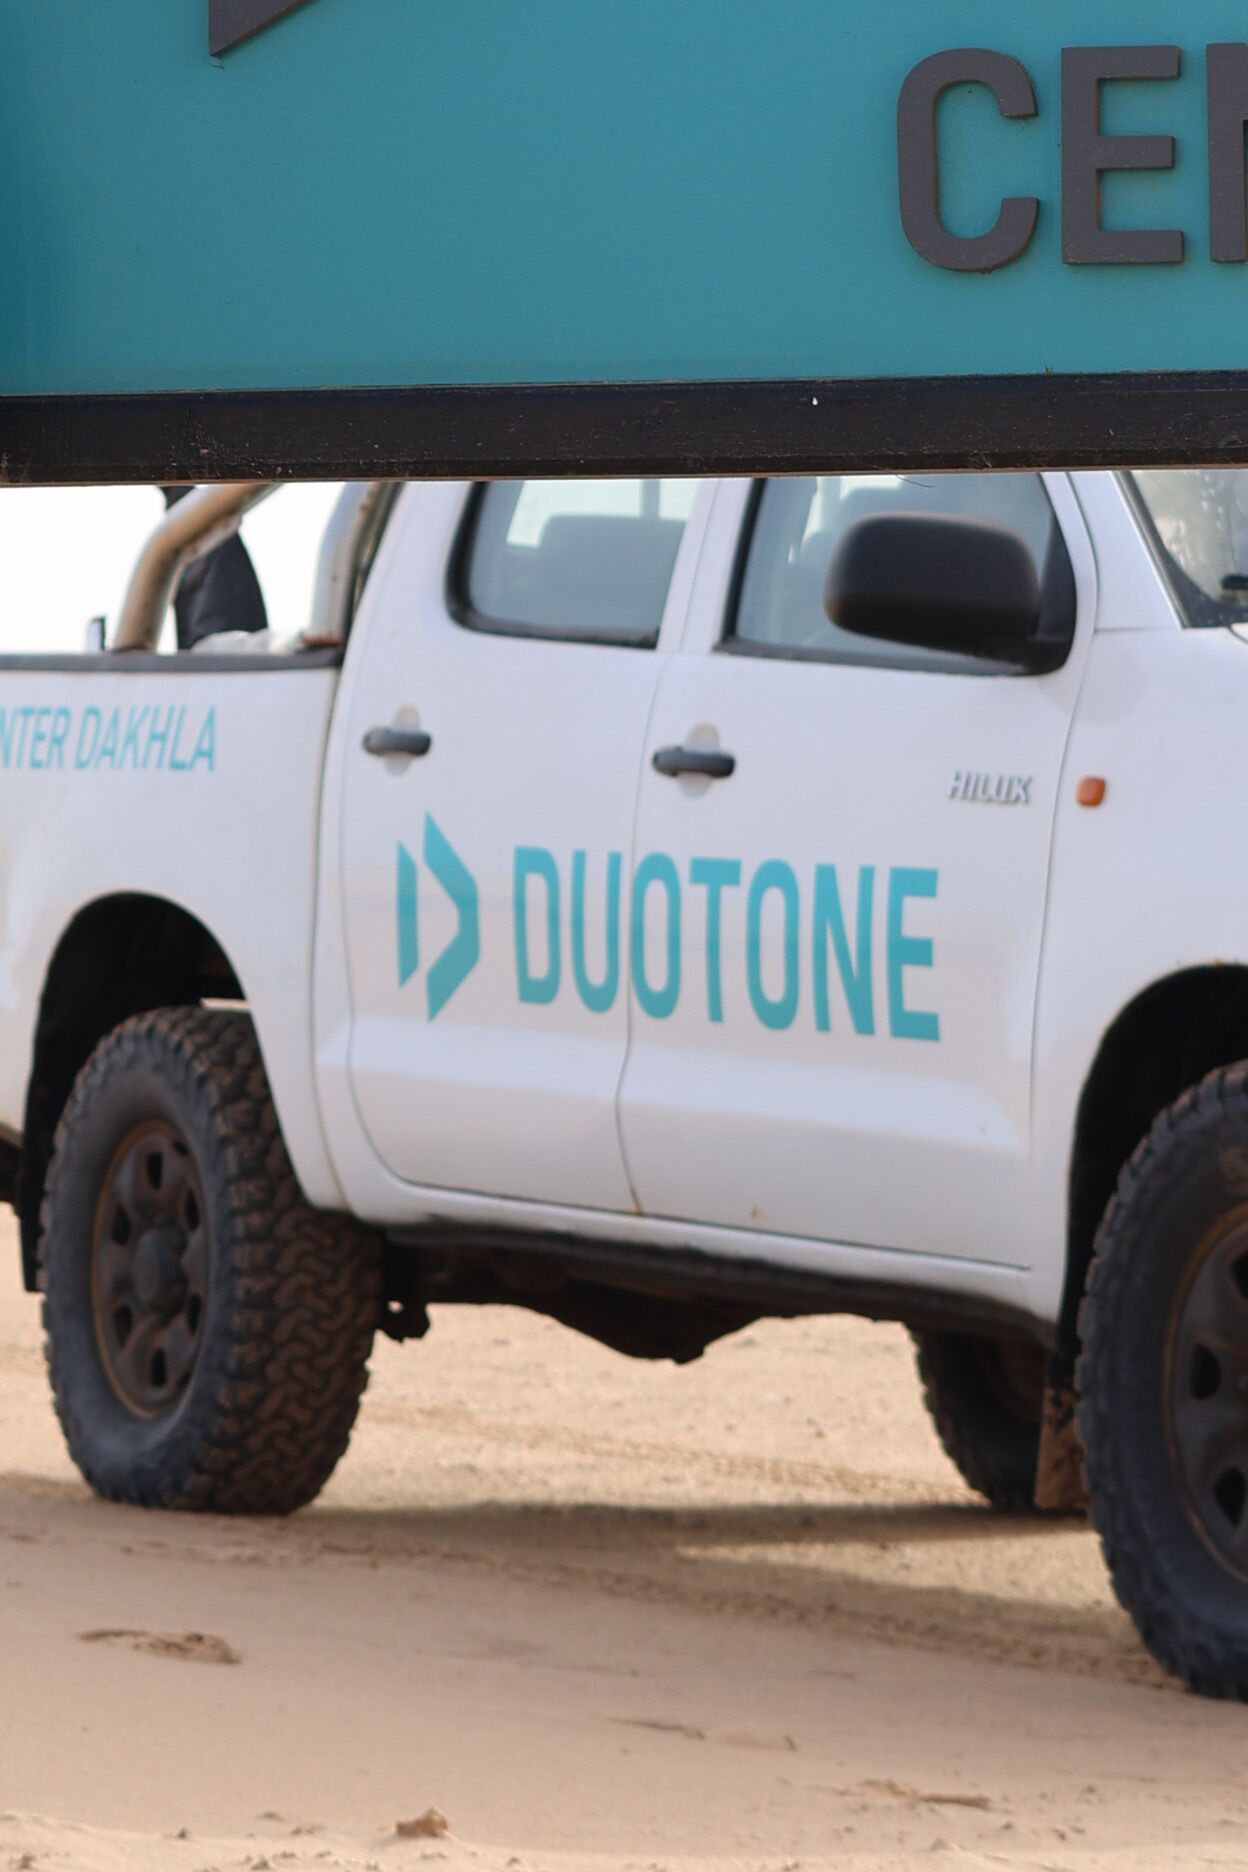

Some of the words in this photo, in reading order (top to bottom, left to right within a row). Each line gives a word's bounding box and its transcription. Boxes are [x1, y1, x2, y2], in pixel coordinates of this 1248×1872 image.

[74, 704, 216, 771] DAKHLA
[949, 769, 1033, 806] HILUX
[513, 845, 941, 1042] DUOTONE
